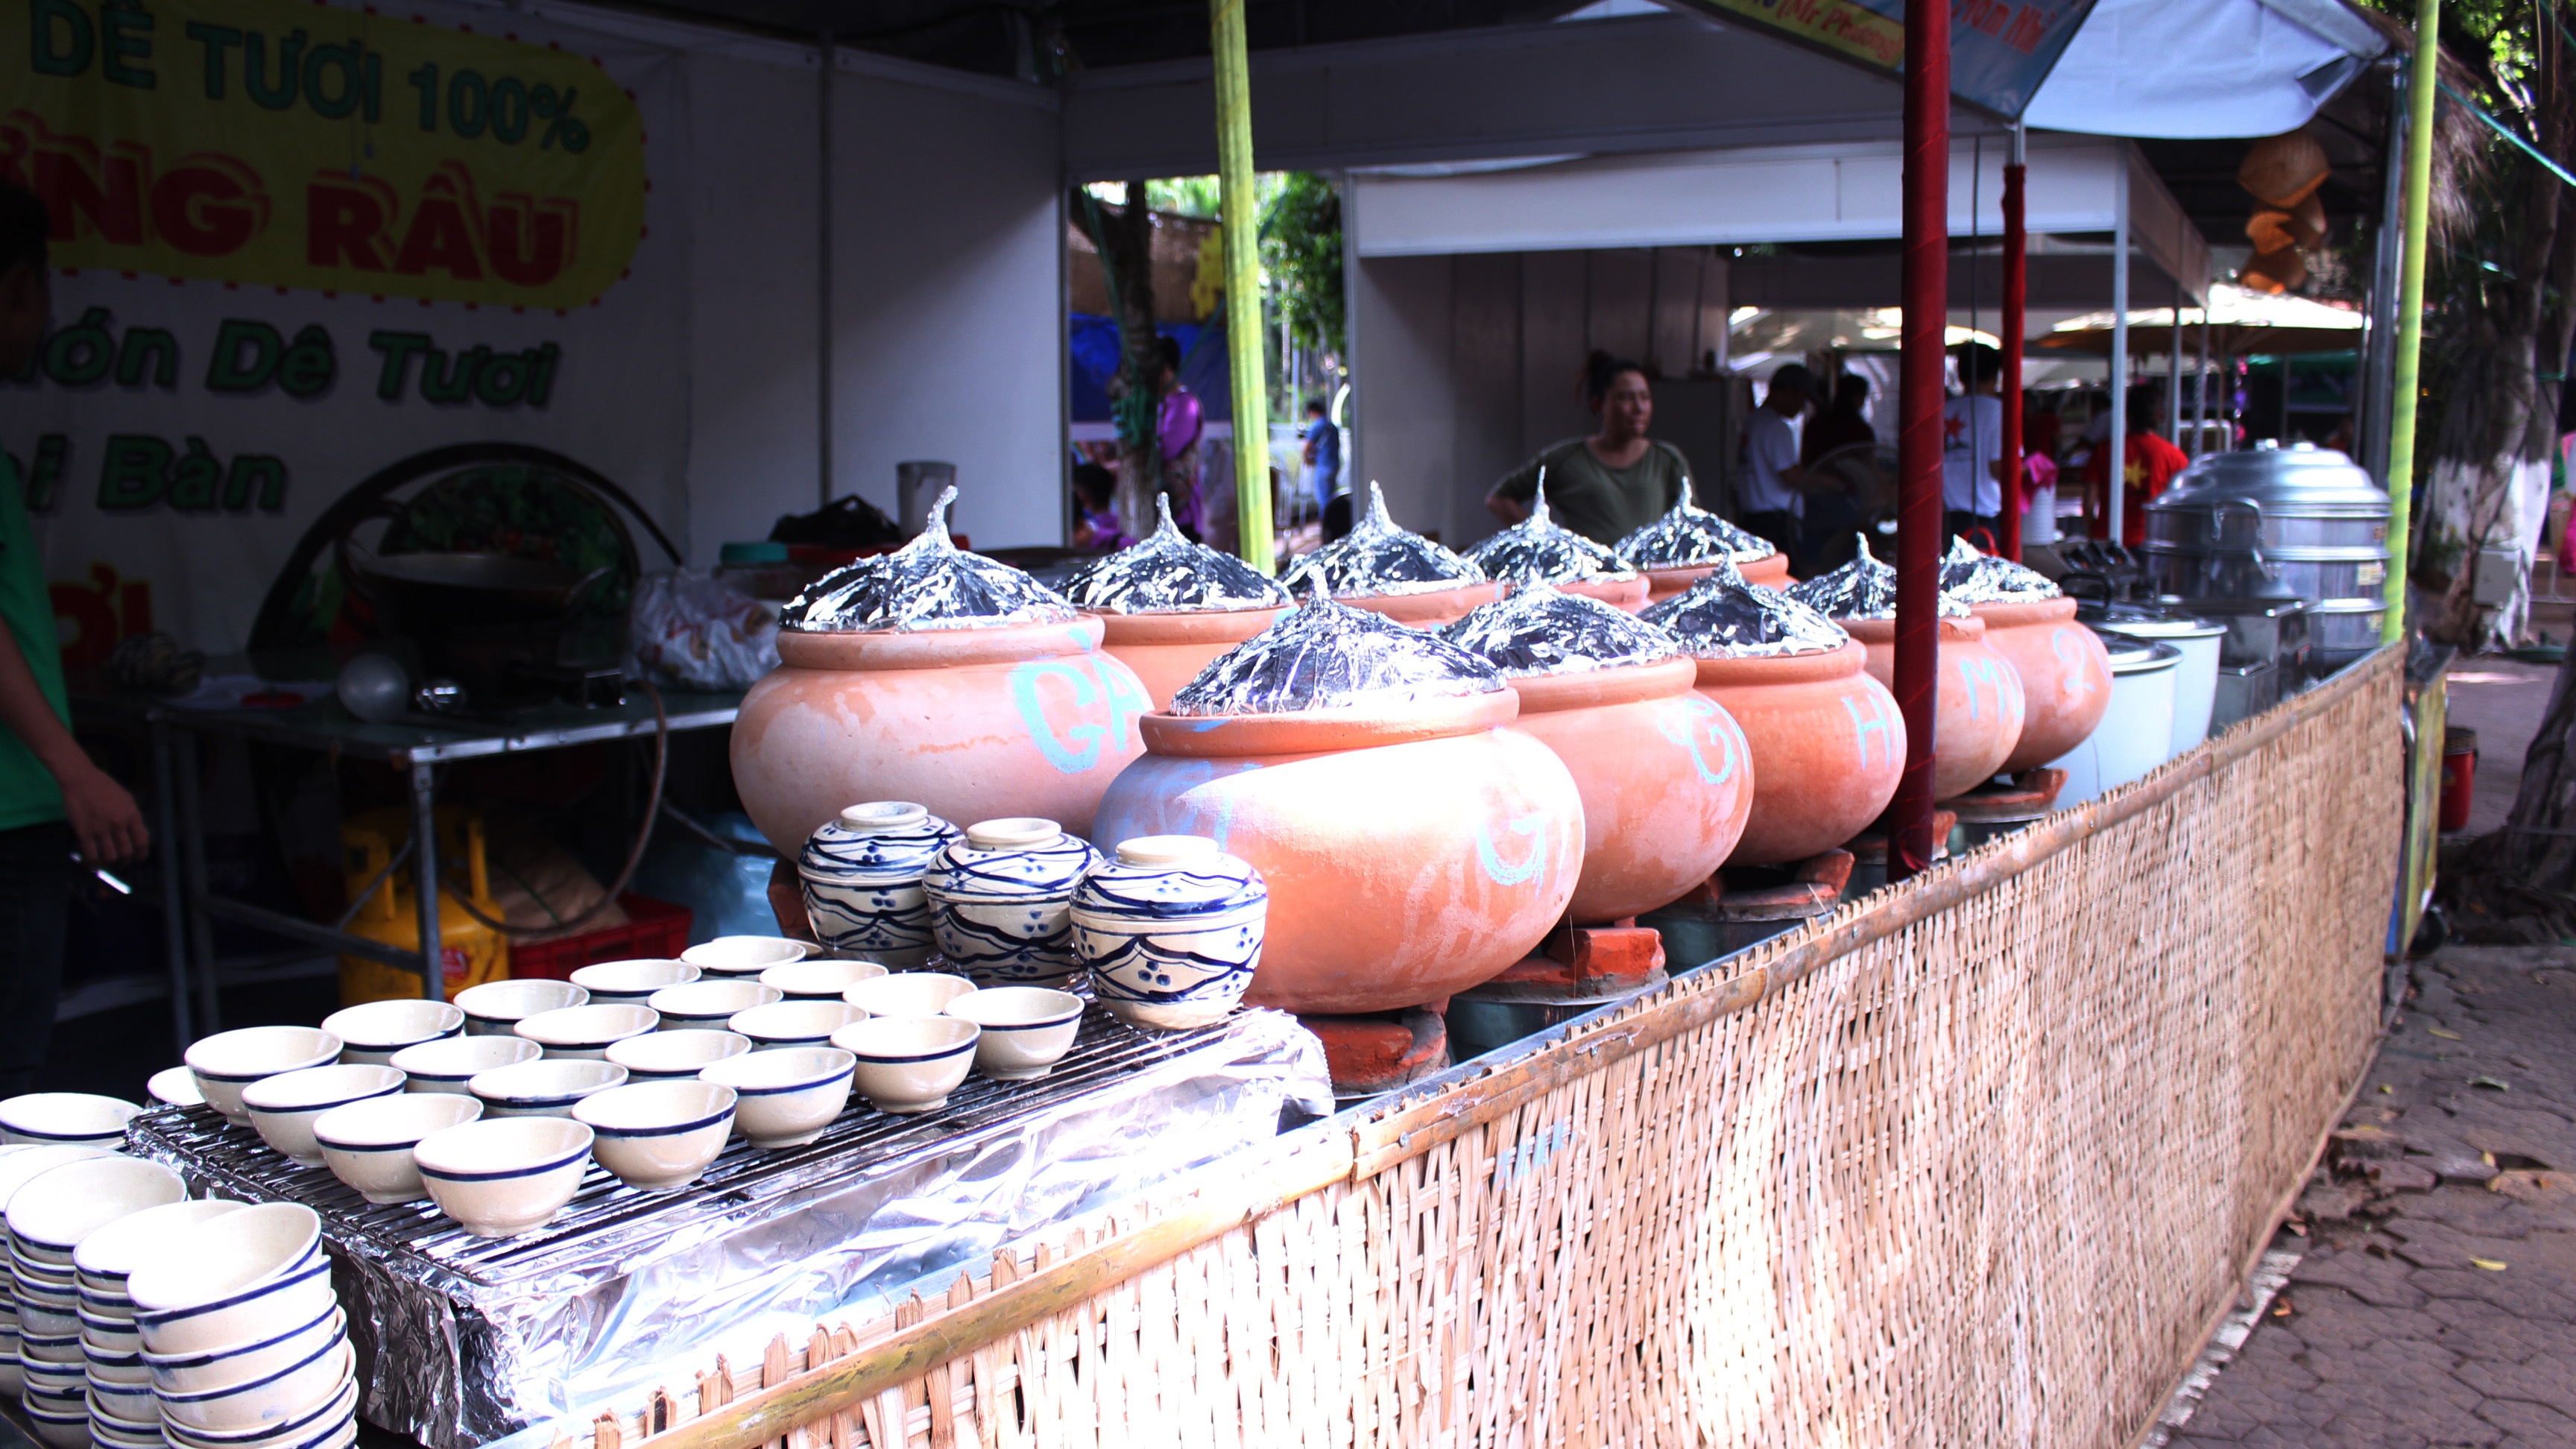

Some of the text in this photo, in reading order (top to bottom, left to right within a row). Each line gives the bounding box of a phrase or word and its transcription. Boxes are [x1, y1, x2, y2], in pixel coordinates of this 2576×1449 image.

[186, 21, 382, 124] TƯƠI
[409, 63, 589, 154] 100%
[0, 112, 578, 287] NG RÂU
[10, 306, 561, 407] ón Dê Tươi
[97, 434, 287, 512] Bàn
